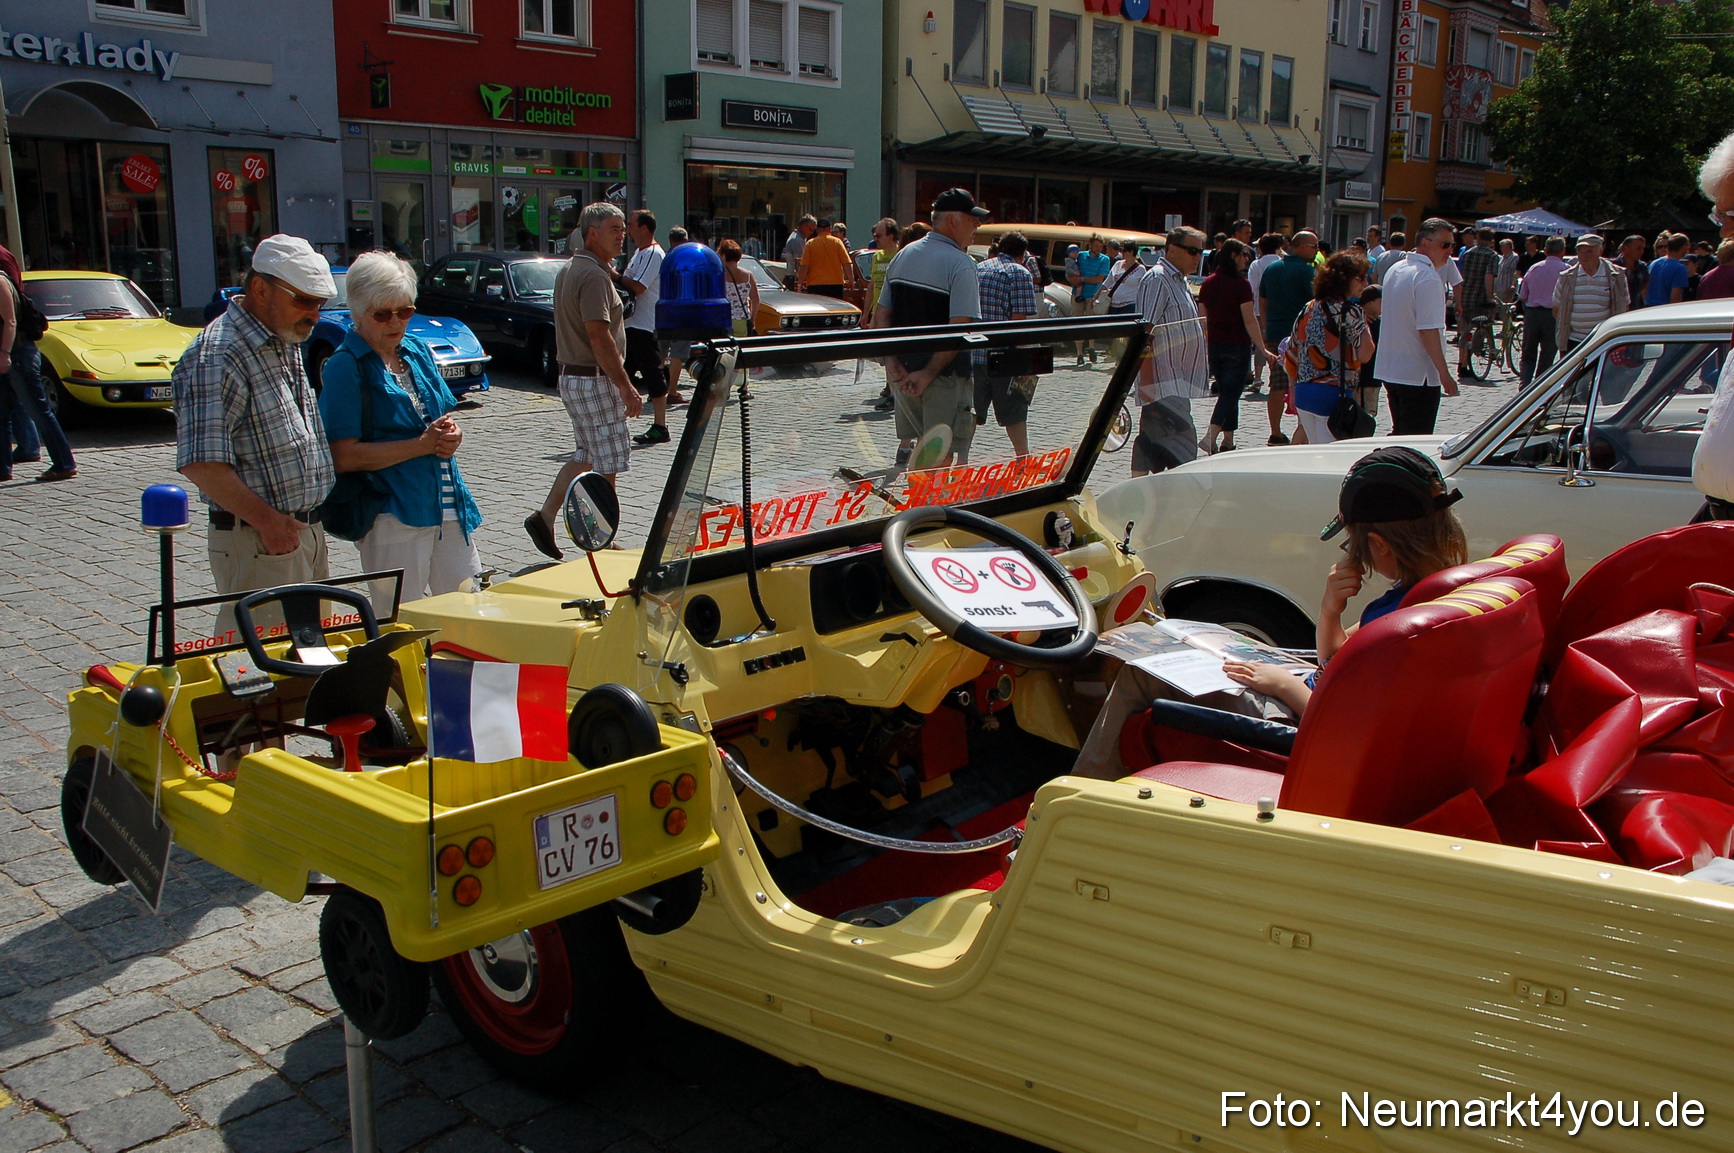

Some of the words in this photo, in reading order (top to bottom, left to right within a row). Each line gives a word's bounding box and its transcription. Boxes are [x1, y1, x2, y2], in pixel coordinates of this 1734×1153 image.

[80, 32, 180, 82] lady
[1394, 0, 1413, 129] BÄCKEREI
[525, 86, 612, 108] mobilcom
[525, 106, 577, 126] debitel
[123, 165, 158, 188] SALE!
[454, 162, 490, 173] GRAVIS
[964, 604, 1017, 616] sonst:
[92, 797, 111, 819] Bitte
[111, 816, 129, 840] nicht
[563, 813, 579, 842] R
[544, 844, 576, 878] CV
[585, 833, 614, 866] 76
